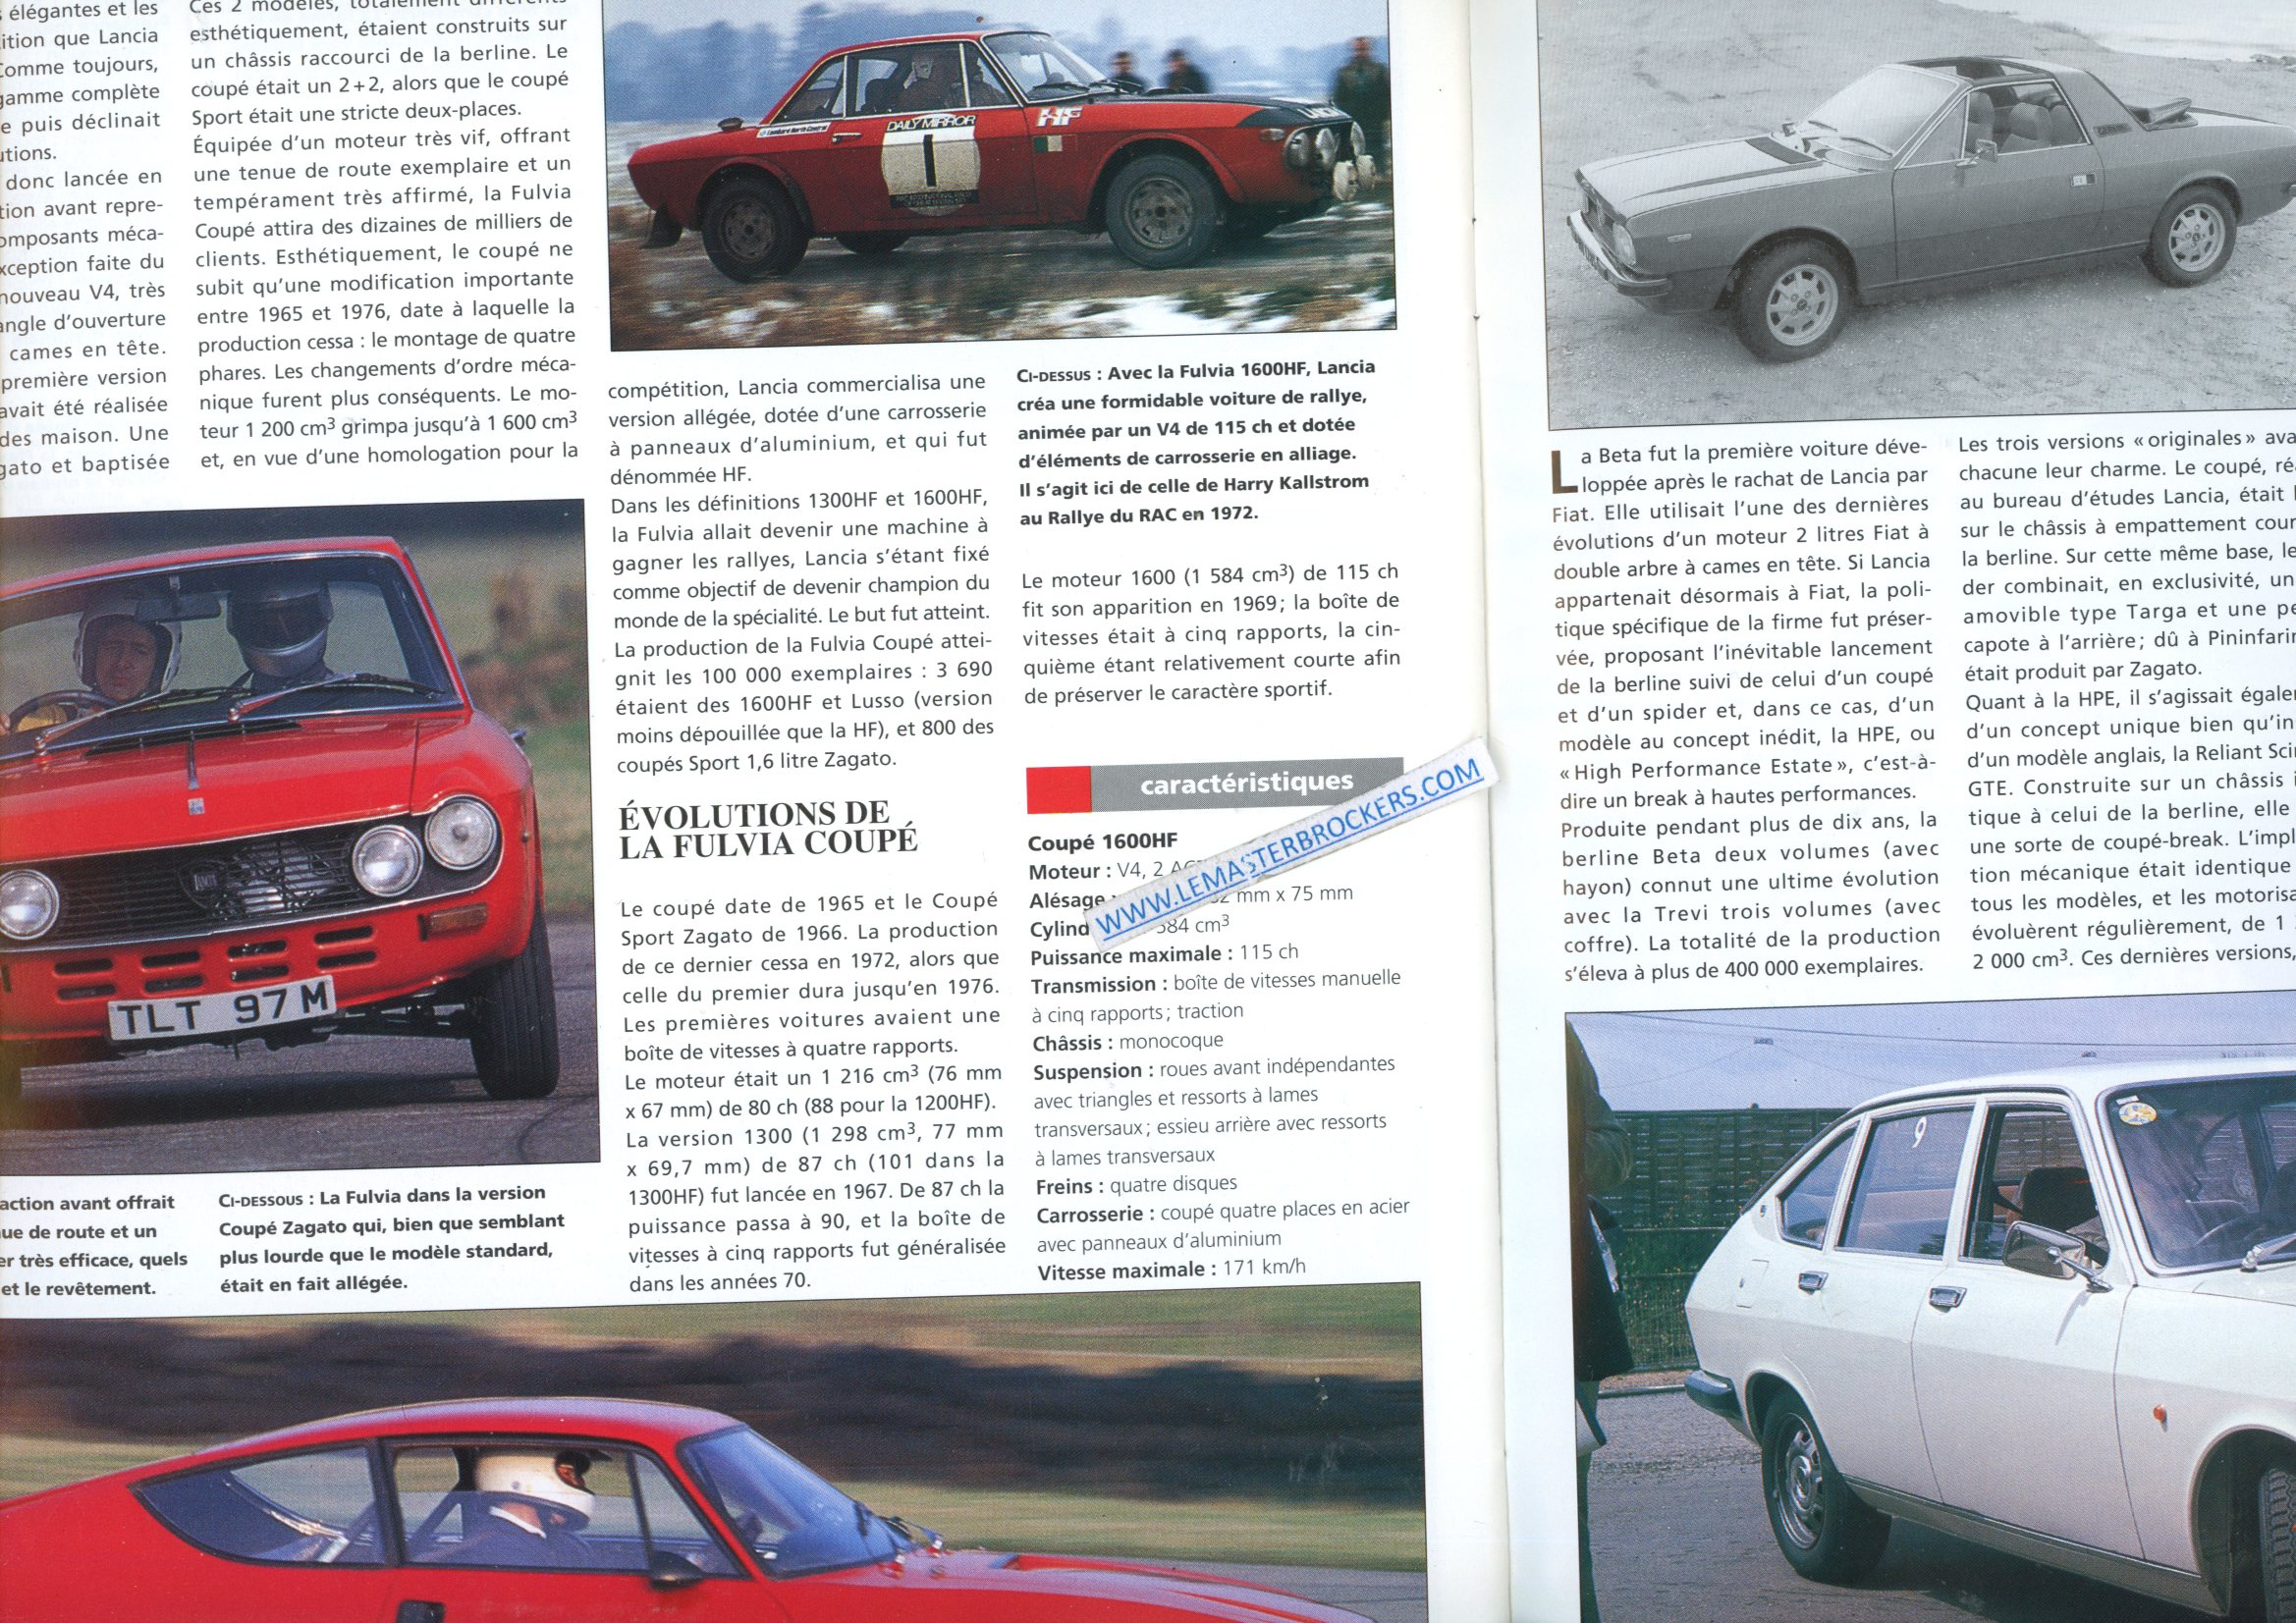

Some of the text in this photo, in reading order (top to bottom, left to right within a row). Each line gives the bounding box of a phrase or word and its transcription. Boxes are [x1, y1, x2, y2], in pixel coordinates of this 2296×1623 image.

[191, 17, 567, 42] esthétiquement, étaient construits sur
[887, 115, 977, 132] DAILY MIRROR
[1036, 107, 1083, 127] HF
[194, 135, 271, 157] Équipée
[336, 135, 407, 148] moteur
[415, 131, 452, 146] très
[461, 129, 489, 146] vif,
[501, 128, 571, 143] offrant
[923, 134, 936, 188] 1
[6, 170, 161, 190] donc lancée en
[195, 212, 573, 242] Coupé attira des dizaines de milliers de
[197, 298, 574, 324] entre 1965 et 1976, date à laquelle la
[10, 340, 165, 360] cames en tête.
[1017, 389, 1366, 411] créa une formidable voiture de rallye,
[1020, 483, 1030, 497] Il
[1095, 481, 1113, 495] ici
[1121, 480, 1142, 494] de
[1148, 479, 1189, 493] celle
[1196, 478, 1218, 492] de
[1225, 478, 1274, 494] Harry
[1281, 475, 1369, 489] Kallstrom
[612, 489, 987, 514] Dans les définitions 1300HF et 1600HF,
[1554, 507, 1594, 522] Fiat.
[1606, 504, 1639, 519] Elle
[1651, 502, 1724, 518] utilisait
[1793, 498, 1826, 514] des
[1836, 496, 1928, 513] dernières
[1020, 506, 1258, 527] au Rallye du RAC en 1972.
[1556, 581, 1931, 612] appartenait désormais à Fiat, la poli-
[616, 632, 991, 661] La production de la Fulvia Coupé attei-
[1557, 650, 1594, 667] vée,
[1606, 647, 1704, 668] proposant
[1831, 640, 1933, 656] lancement
[1965, 662, 2202, 683] était produit par Zagato.
[1140, 770, 1354, 797] caractéristiques
[619, 799, 891, 831] ÉVOLUTIONS DE
[1969, 800, 2289, 829] tique à celui de la berline, elle
[620, 821, 919, 859] LA FULVIA COUPÉ
[1028, 832, 1178, 856] Coupé 1600HF
[1094, 758, 1484, 938] WWW.LEMASTERBROCKERS.COM
[1970, 858, 2290, 883] tion mécanique était identique
[624, 987, 667, 1003] celle
[678, 986, 701, 1001] du
[713, 984, 789, 1004] premier
[799, 983, 844, 999] dura
[950, 978, 999, 994] 1976.
[117, 980, 328, 1035] TLT 97 M
[625, 1009, 1000, 1035] Les premières voitures avaient une
[1034, 1087, 1318, 1110] avec triangles et ressorts à lames
[1036, 1150, 1215, 1166] à lames transversaux
[1037, 1178, 1092, 1195] Freins
[1111, 1178, 1166, 1197] quatre
[1174, 1175, 1236, 1194] disques
[220, 1214, 565, 1238] Coupé Zagato qui, bien que semblant
[1038, 1240, 1075, 1252] avec
[1083, 1238, 1167, 1255] panneaux
[1, 1282, 155, 1296] et le revêtement.
[221, 1275, 408, 1293] était en fait allégée.
